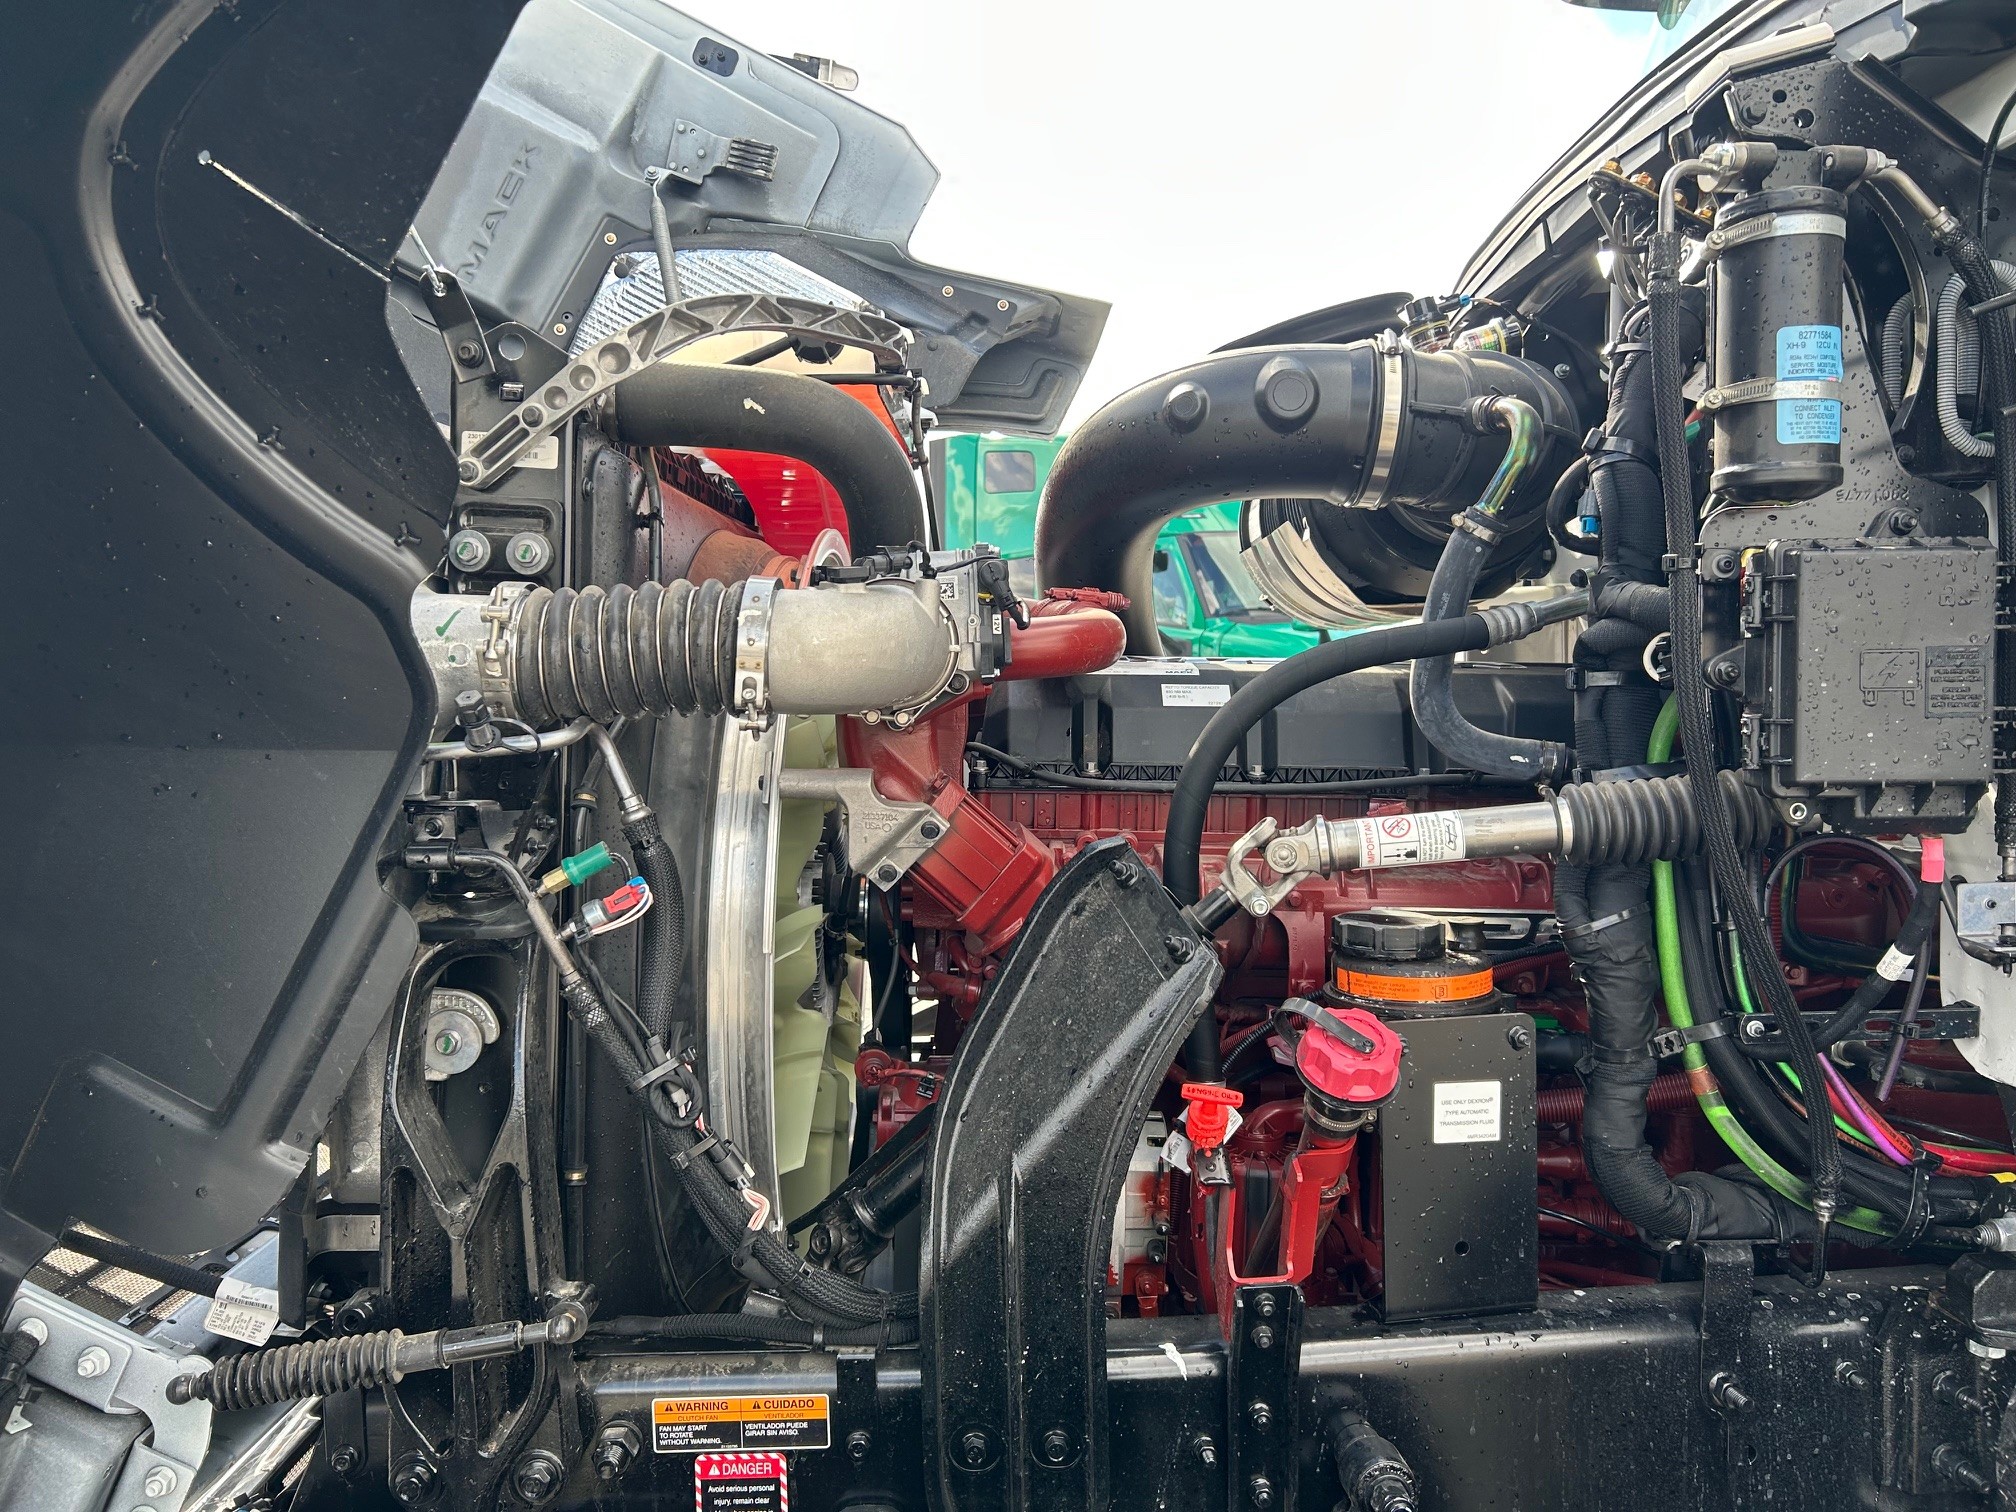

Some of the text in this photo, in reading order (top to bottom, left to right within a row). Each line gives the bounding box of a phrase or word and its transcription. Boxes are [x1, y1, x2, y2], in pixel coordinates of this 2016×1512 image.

[454, 140, 540, 284] MACK
[1798, 331, 1832, 340] 82771584
[1786, 341, 1807, 350] XH-9
[864, 821, 882, 830] USA
[675, 1401, 729, 1412] WARNING
[763, 1399, 815, 1409] CUIDADO
[687, 1424, 708, 1432] START
[744, 1421, 809, 1430] VENTILADOR PUEDE
[778, 1428, 800, 1436] AVISO.
[722, 1462, 773, 1475] DANGER
[707, 1485, 725, 1493] Avoid
[748, 1484, 775, 1493] personal
[713, 1497, 732, 1507] injury,
